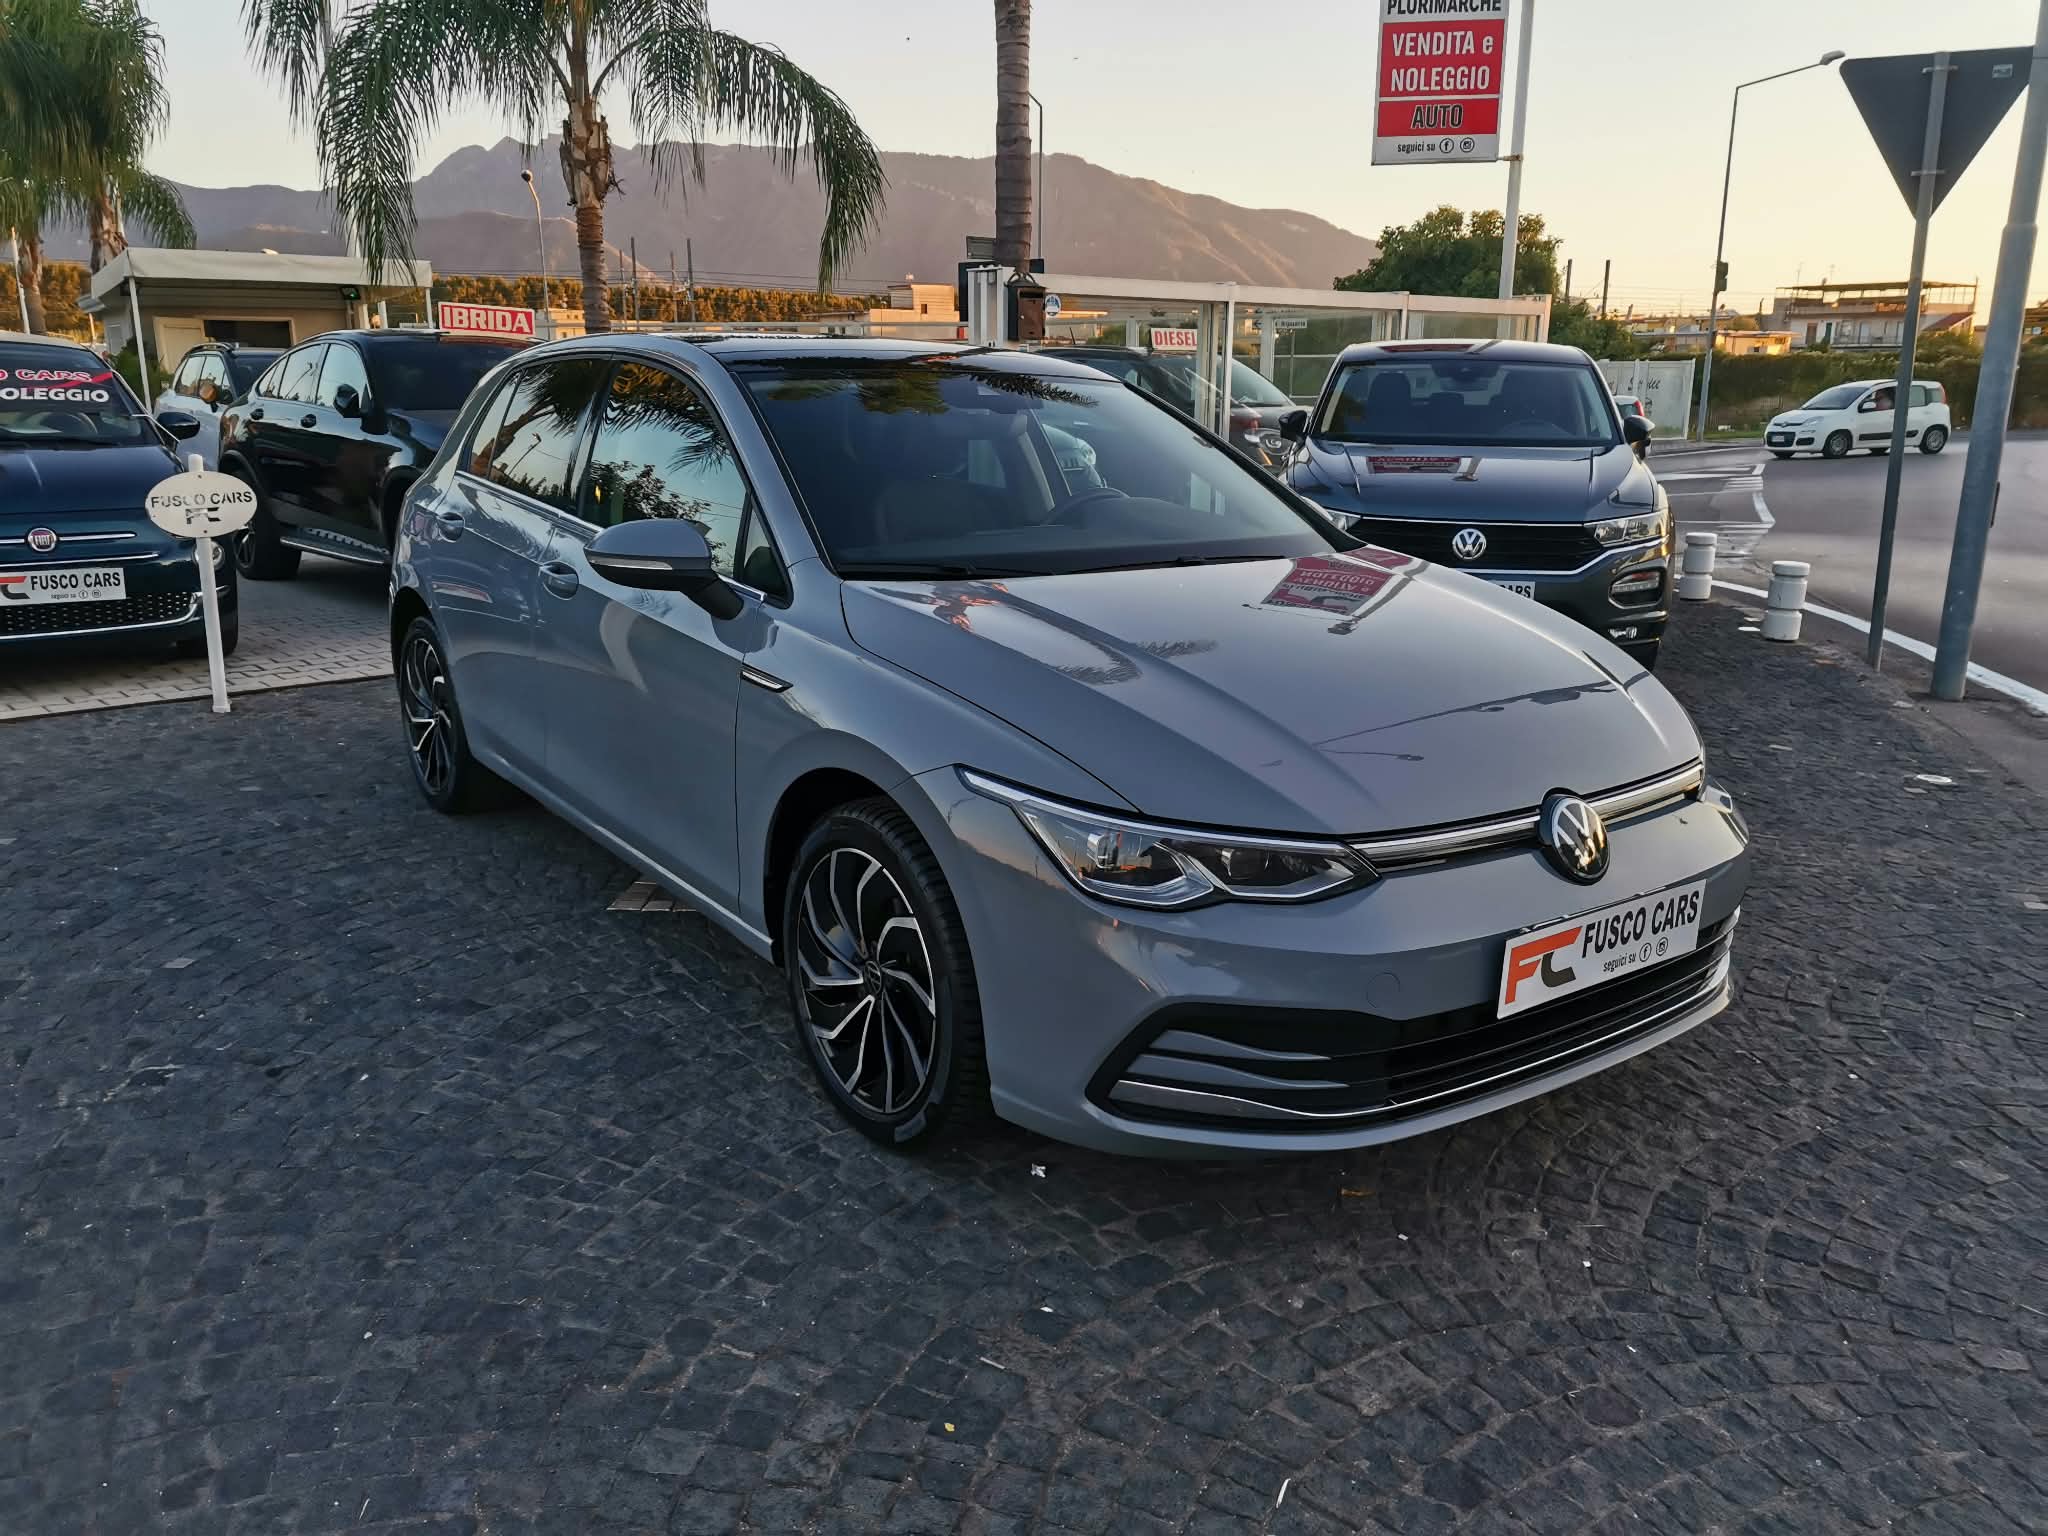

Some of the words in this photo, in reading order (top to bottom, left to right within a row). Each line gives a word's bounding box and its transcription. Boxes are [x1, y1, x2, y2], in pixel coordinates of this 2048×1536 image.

[1387, 0, 1502, 15] PLURIMARCHE
[1392, 30, 1475, 57] VENDITA
[1482, 35, 1494, 55] e
[1391, 65, 1491, 92] NOLEGGIO
[1411, 104, 1464, 129] AUTO
[1397, 141, 1425, 154] seguici
[1426, 144, 1436, 152] su
[443, 306, 531, 333] IBRIDA
[1154, 330, 1198, 347] DIESEL
[16, 369, 93, 382] CARS
[151, 494, 206, 508] FUSCO
[210, 491, 253, 505] CARS
[30, 574, 79, 591] FUSCO
[84, 572, 121, 588] CARS
[1582, 907, 1648, 958] FUSCO
[1651, 890, 1700, 936] CARS
[1603, 956, 1627, 972] seguici
[1628, 952, 1636, 964] su
